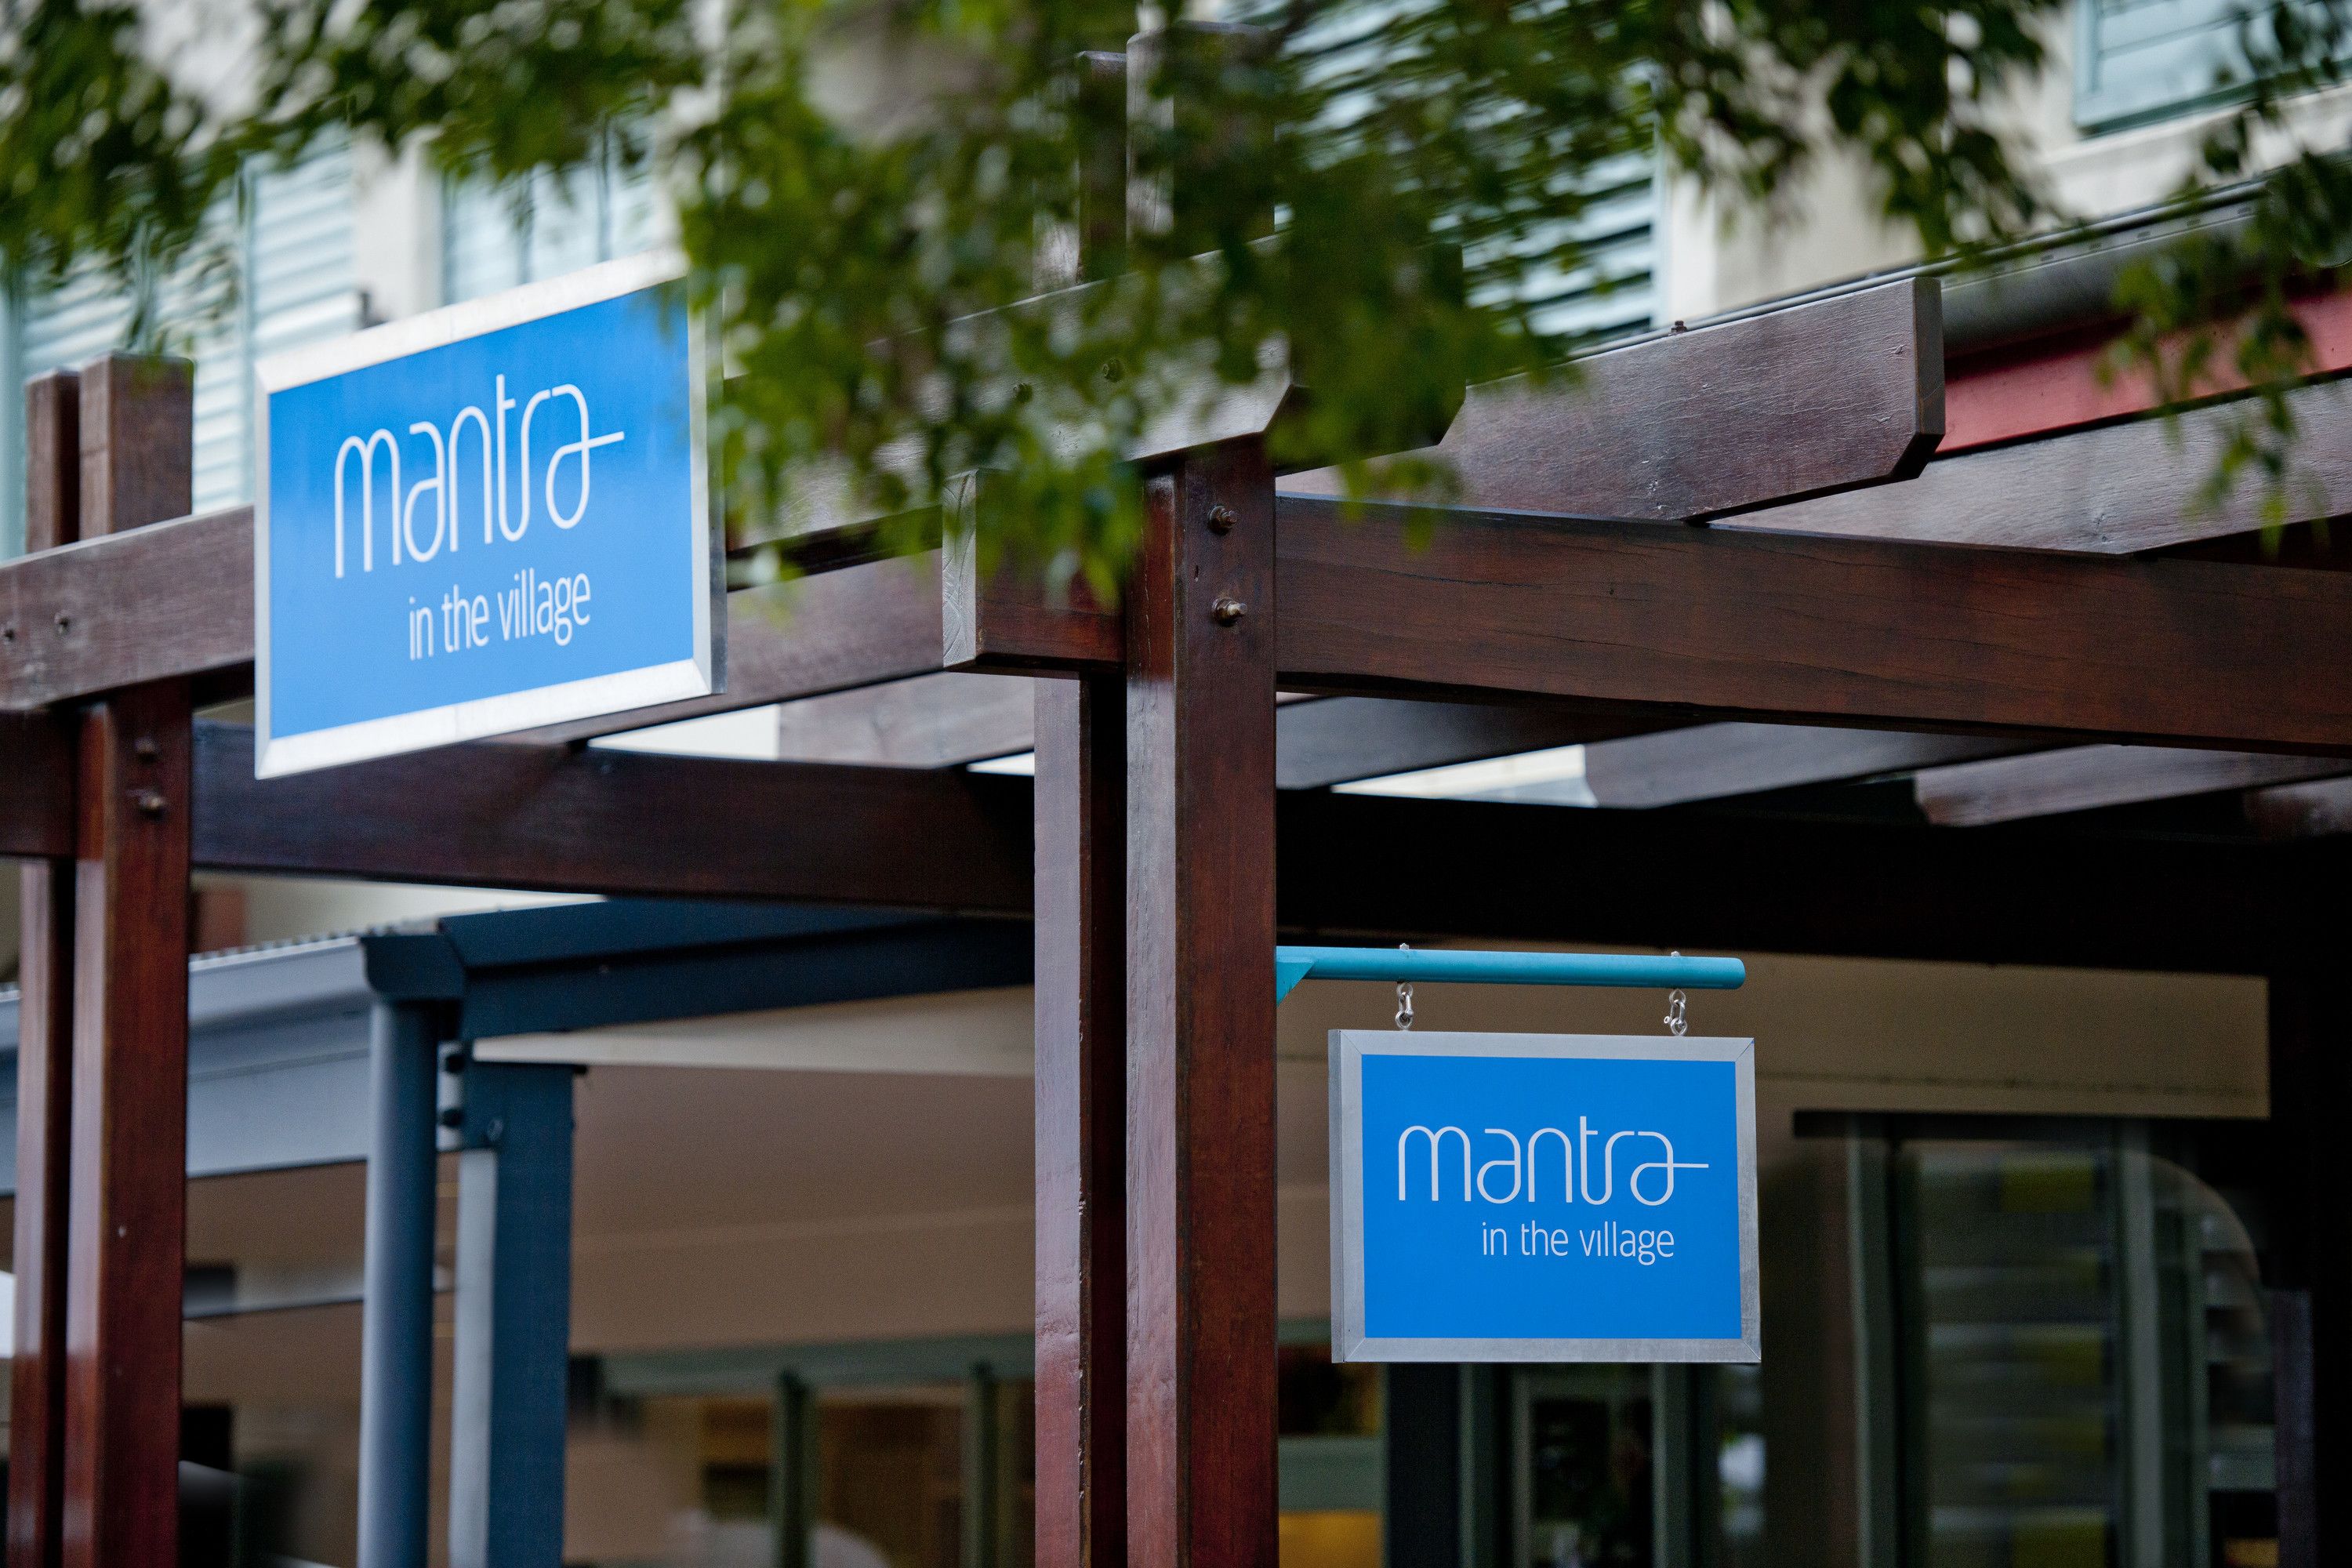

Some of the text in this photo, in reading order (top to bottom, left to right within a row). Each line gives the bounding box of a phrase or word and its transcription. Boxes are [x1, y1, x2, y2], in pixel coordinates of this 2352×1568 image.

[335, 374, 625, 579] mantra
[408, 567, 592, 662] in the village
[1398, 1115, 1709, 1206] mantra
[1482, 1220, 1675, 1265] in the village
